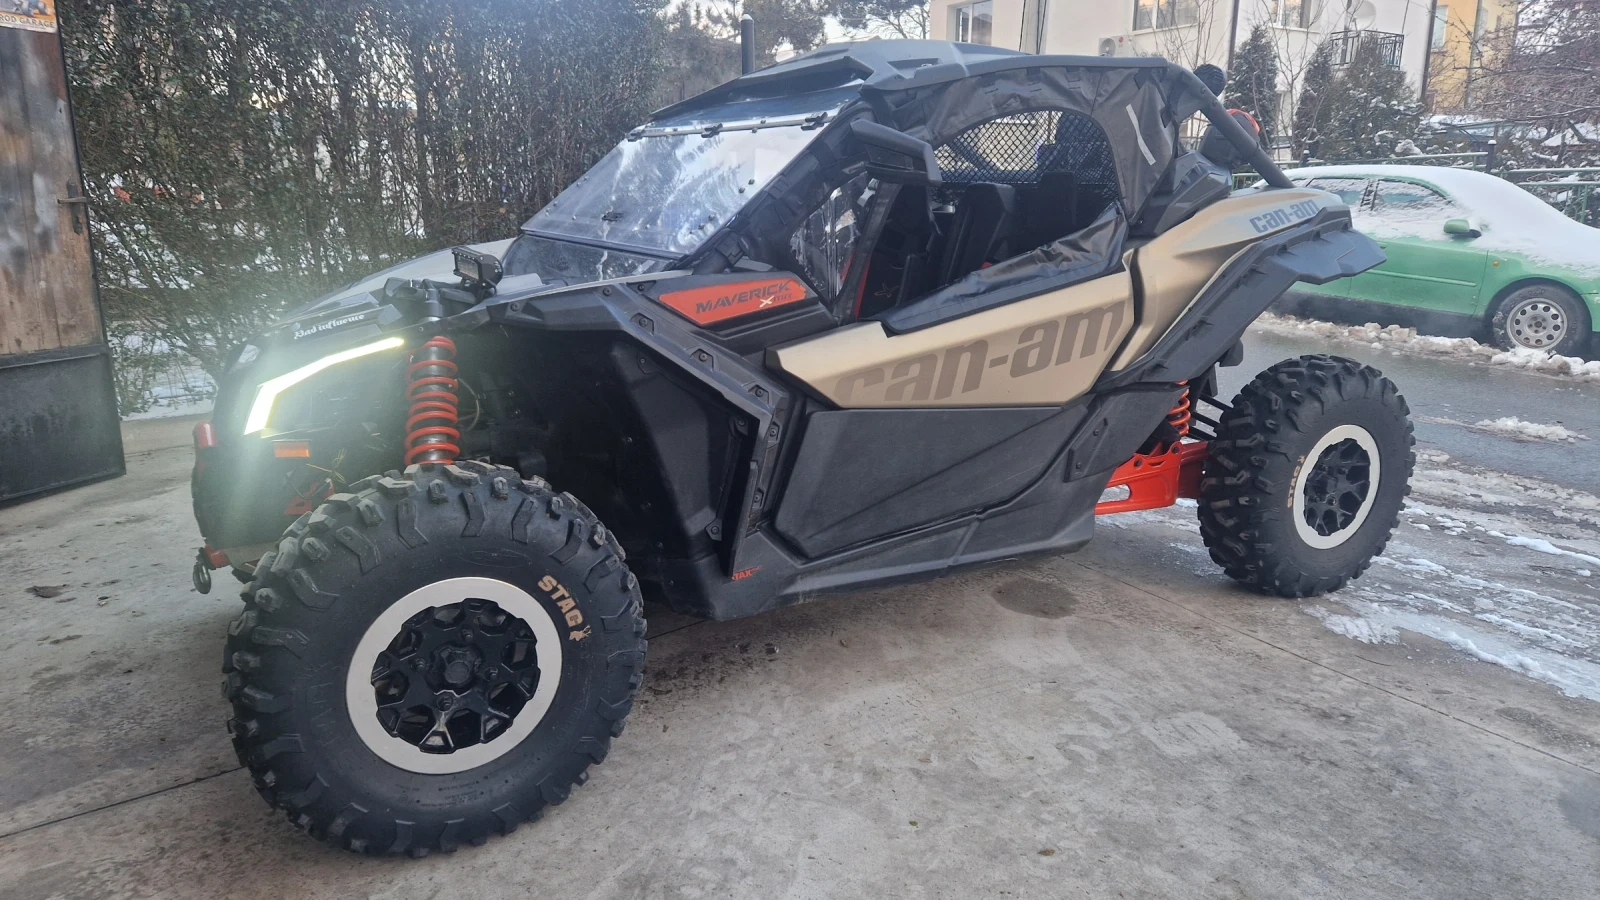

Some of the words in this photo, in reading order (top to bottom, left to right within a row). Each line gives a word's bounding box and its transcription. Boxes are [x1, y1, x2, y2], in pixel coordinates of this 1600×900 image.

[20, 17, 55, 29] GARAGE
[1249, 199, 1320, 234] can-am
[695, 279, 791, 315] MAVERICK
[318, 314, 365, 332] influence
[833, 299, 1126, 402] can-am
[537, 574, 584, 628] STAG
